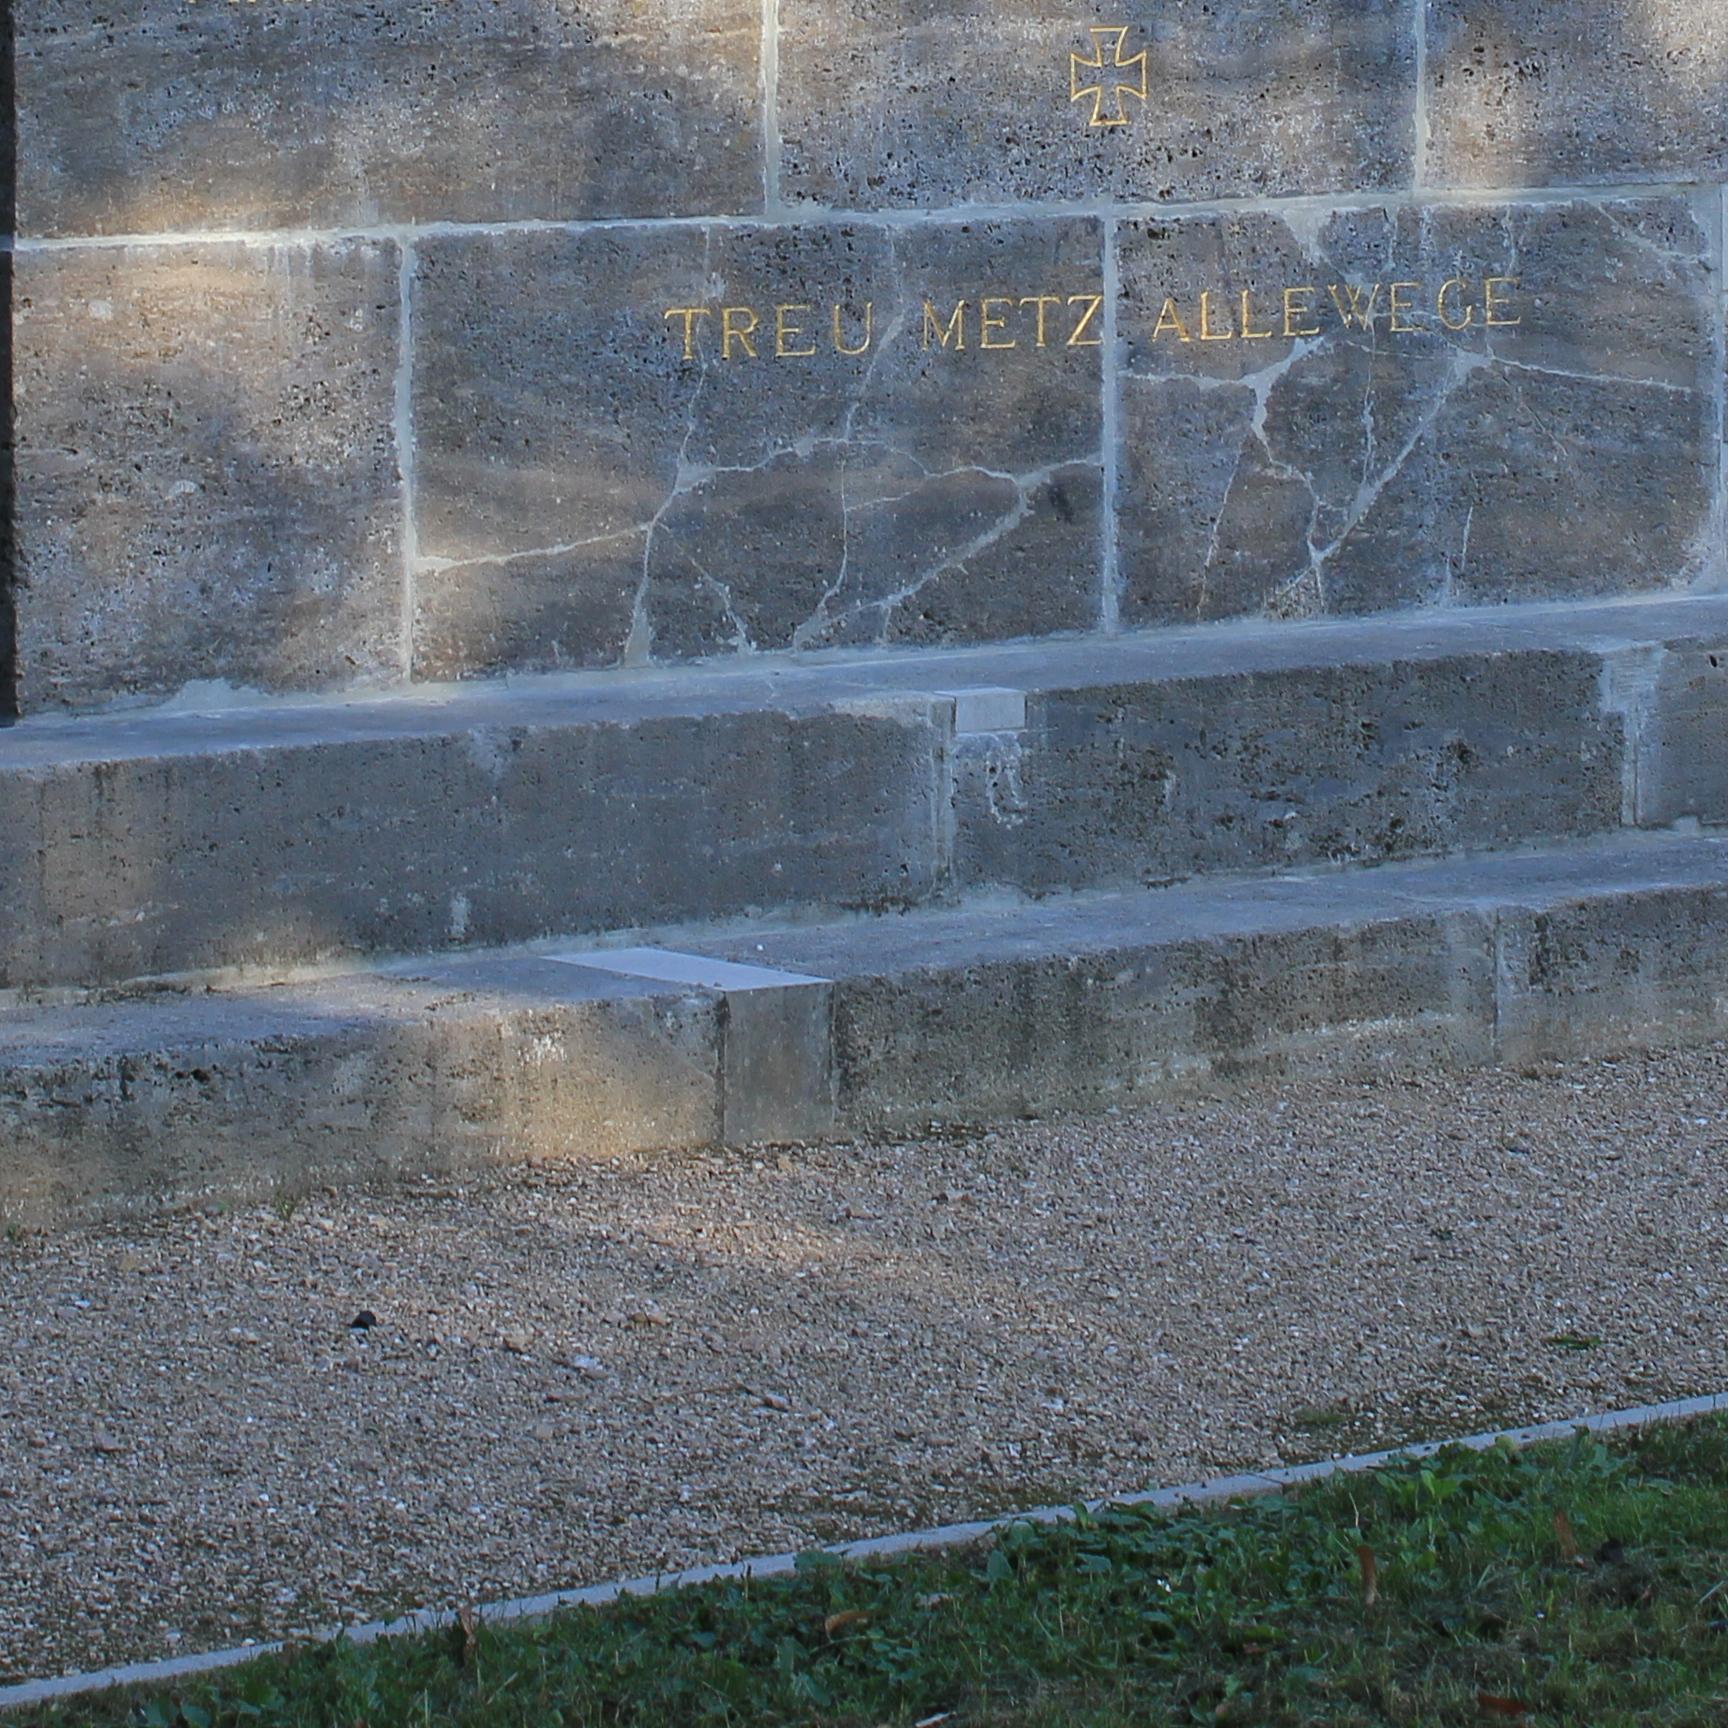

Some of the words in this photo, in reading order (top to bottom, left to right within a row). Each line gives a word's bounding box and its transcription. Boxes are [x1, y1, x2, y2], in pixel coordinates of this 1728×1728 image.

[663, 303, 874, 362] TREU
[922, 294, 1102, 352] METZ
[1151, 276, 1524, 344] ALLEWEGE
